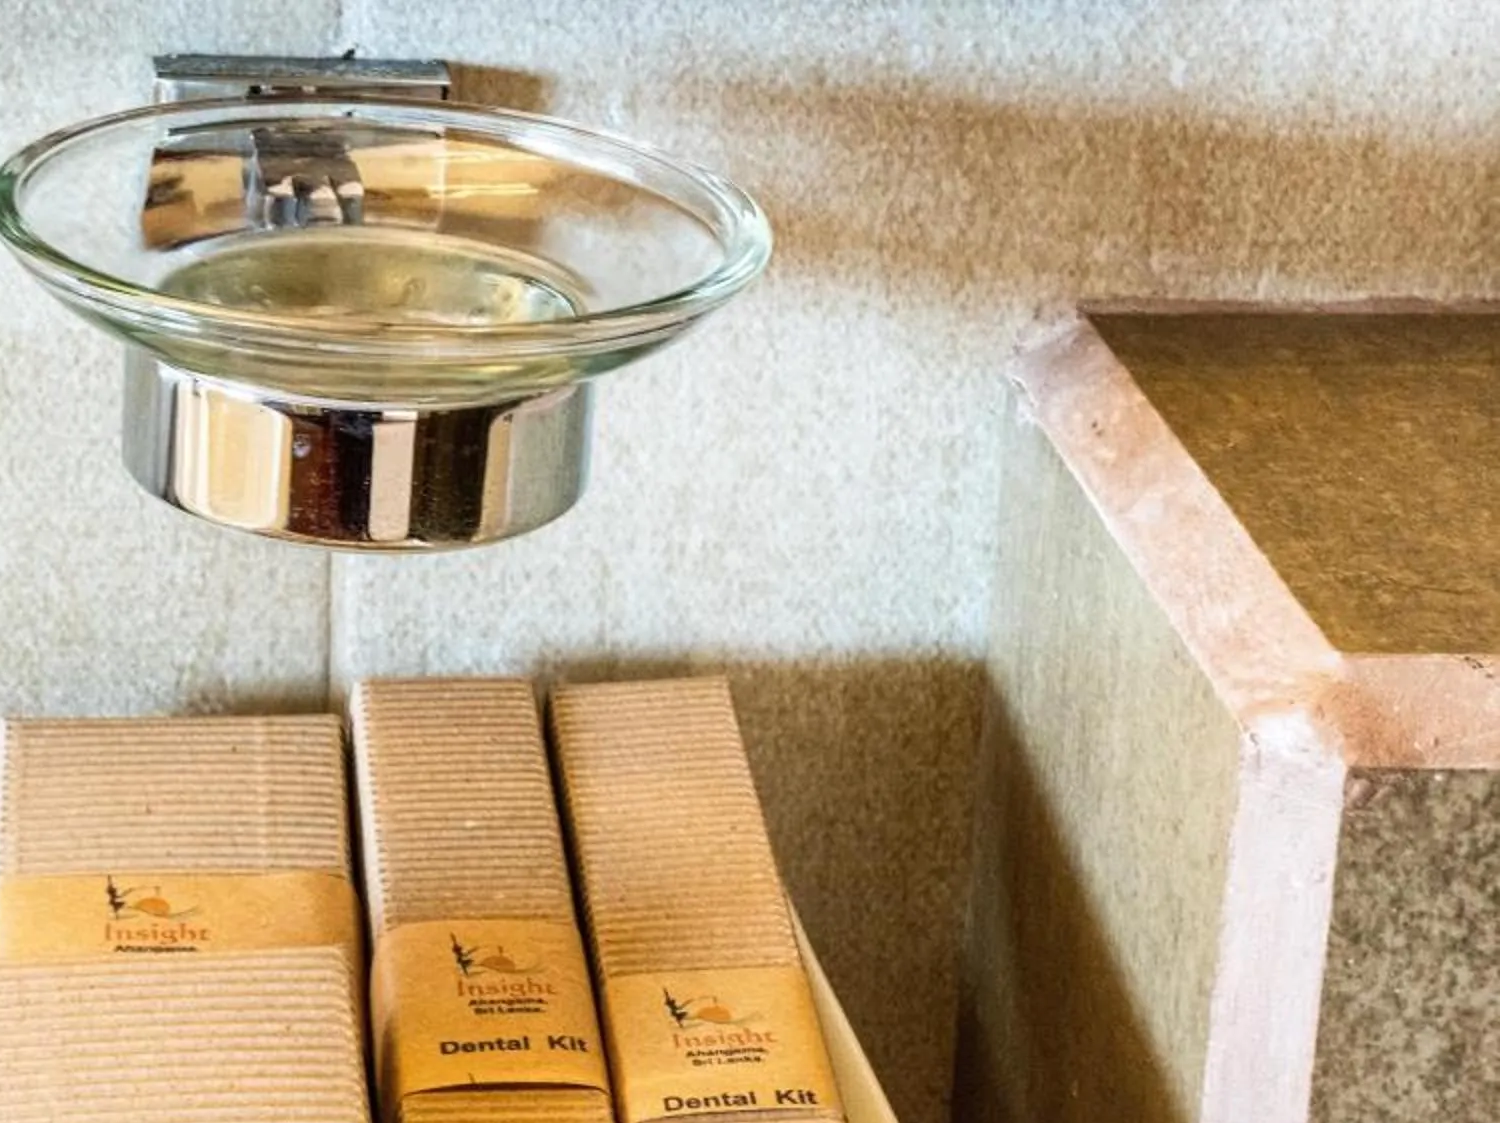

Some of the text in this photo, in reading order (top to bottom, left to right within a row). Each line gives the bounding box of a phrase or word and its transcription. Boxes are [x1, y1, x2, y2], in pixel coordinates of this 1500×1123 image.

[105, 922, 212, 945] Insight
[457, 978, 558, 998] Insight
[439, 1035, 589, 1055] Dental Kit
[672, 1027, 778, 1048] Insight
[692, 1057, 713, 1067] Sri
[663, 1090, 819, 1112] Dental Kit
